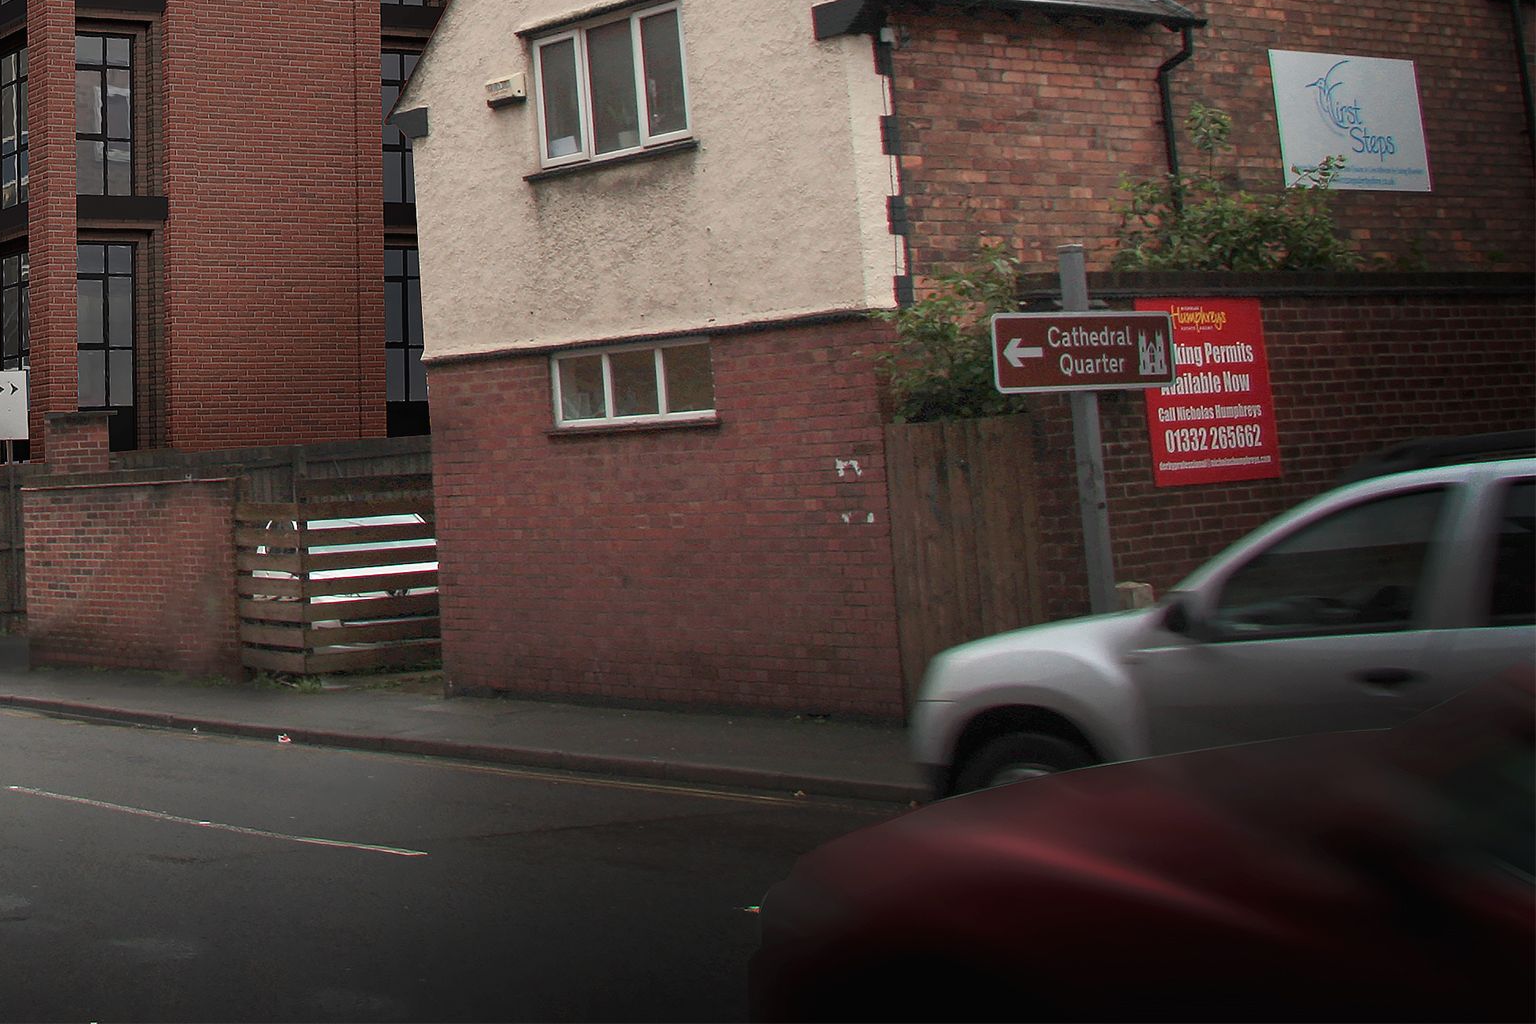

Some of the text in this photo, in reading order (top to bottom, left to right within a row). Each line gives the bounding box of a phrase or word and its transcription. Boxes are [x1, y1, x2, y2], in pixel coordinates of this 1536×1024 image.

[1349, 127, 1395, 162] Steps
[1170, 304, 1226, 333] Humphreys
[1047, 325, 1132, 347] Cathedral
[1059, 353, 1124, 376] Quarter
[1173, 341, 1254, 367] king Permits
[1222, 371, 1250, 392] Now
[1158, 403, 1262, 422] Call Nicholas Humphreys
[1165, 423, 1262, 453] 01332 265662
